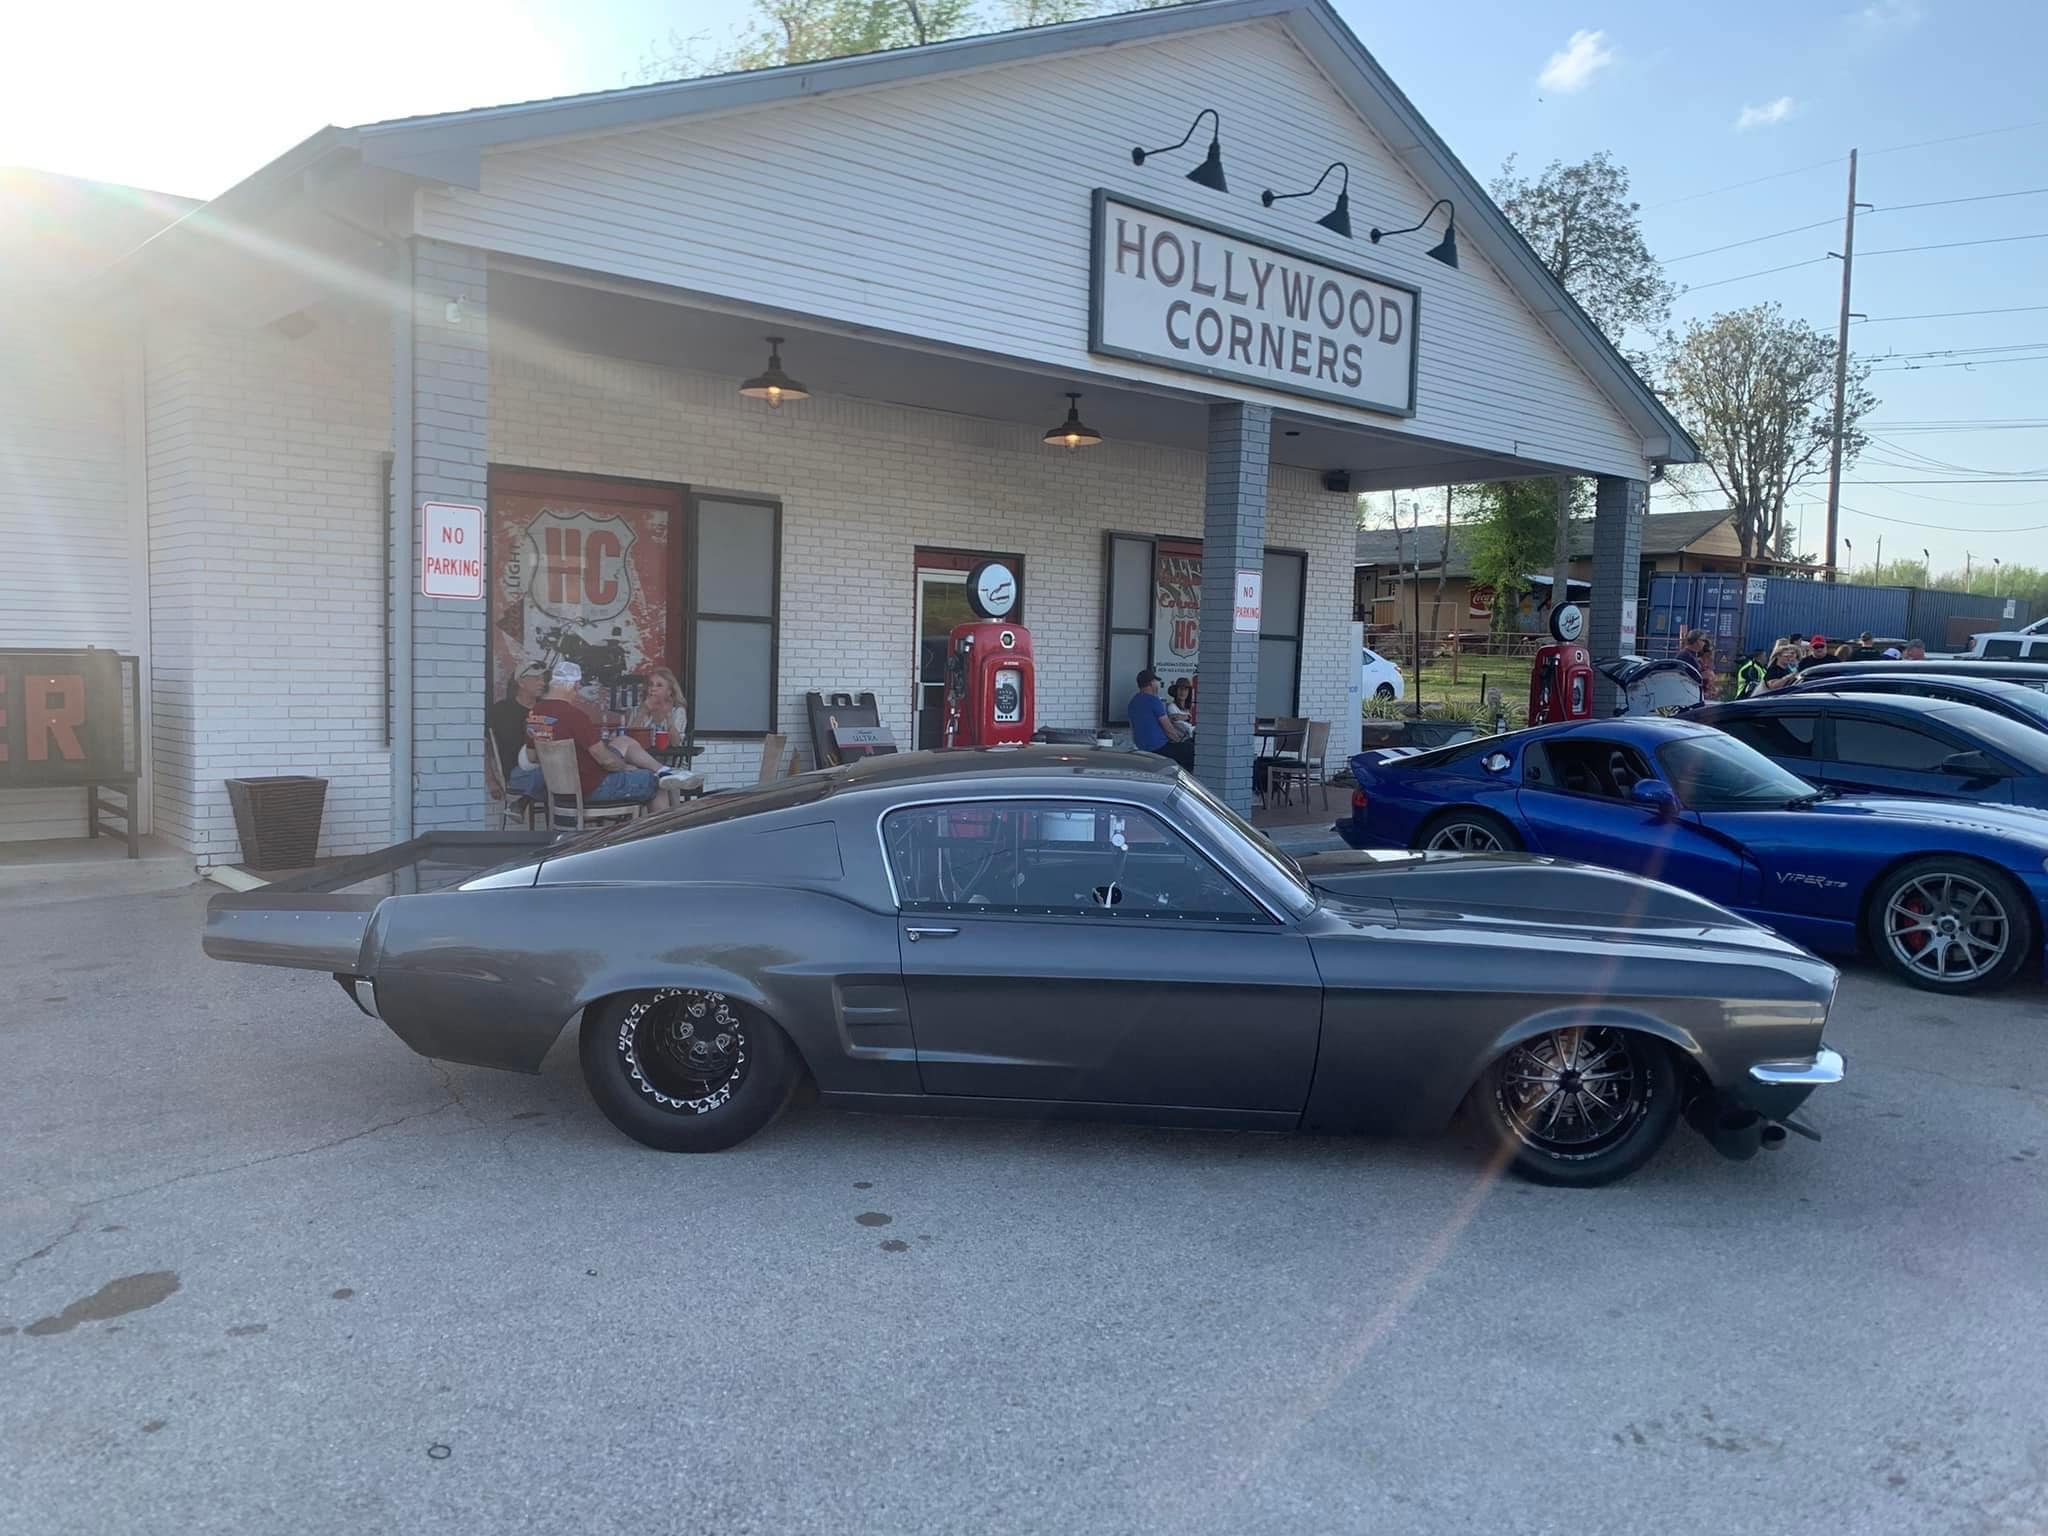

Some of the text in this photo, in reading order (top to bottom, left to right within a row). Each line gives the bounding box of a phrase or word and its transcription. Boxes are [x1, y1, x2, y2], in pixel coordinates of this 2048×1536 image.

[1115, 218, 1402, 345] HOLLYWOOD
[1166, 300, 1362, 387] CORNERS
[442, 527, 464, 544] NO
[427, 556, 479, 576] PARKING
[545, 527, 620, 605] HC
[1243, 586, 1254, 598] NO
[1235, 606, 1260, 618] PARKING
[1175, 621, 1196, 649] HC
[1776, 872, 1826, 888] VIPER
[618, 1003, 640, 1051] WELD
